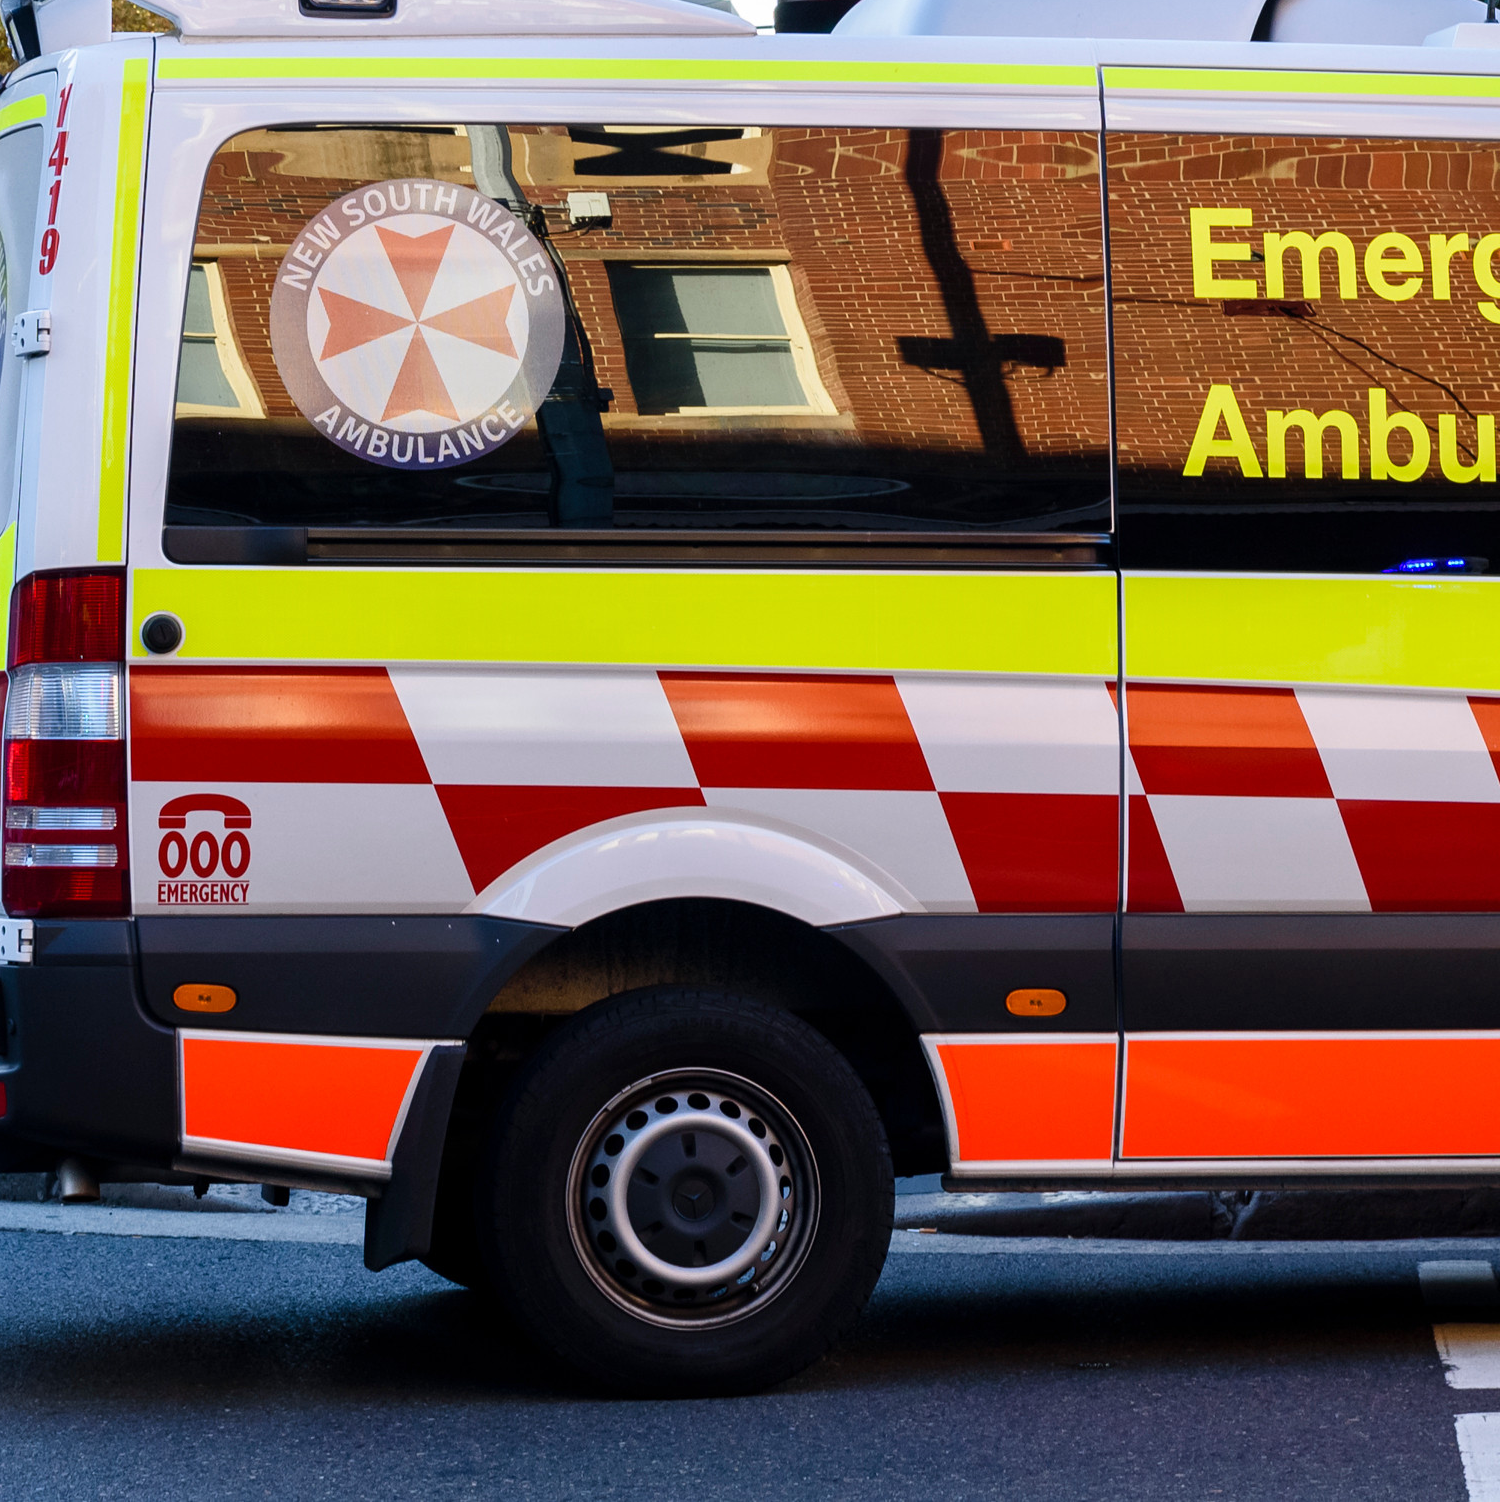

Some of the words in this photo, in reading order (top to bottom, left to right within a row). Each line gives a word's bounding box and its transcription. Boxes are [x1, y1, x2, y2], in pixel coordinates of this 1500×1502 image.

[281, 214, 342, 292] NEW
[341, 183, 459, 227] SOUTH
[466, 196, 554, 297] WALES
[313, 399, 525, 464] AMBULANCE
[158, 830, 251, 879] 000
[158, 883, 249, 903] EMERGENCY
